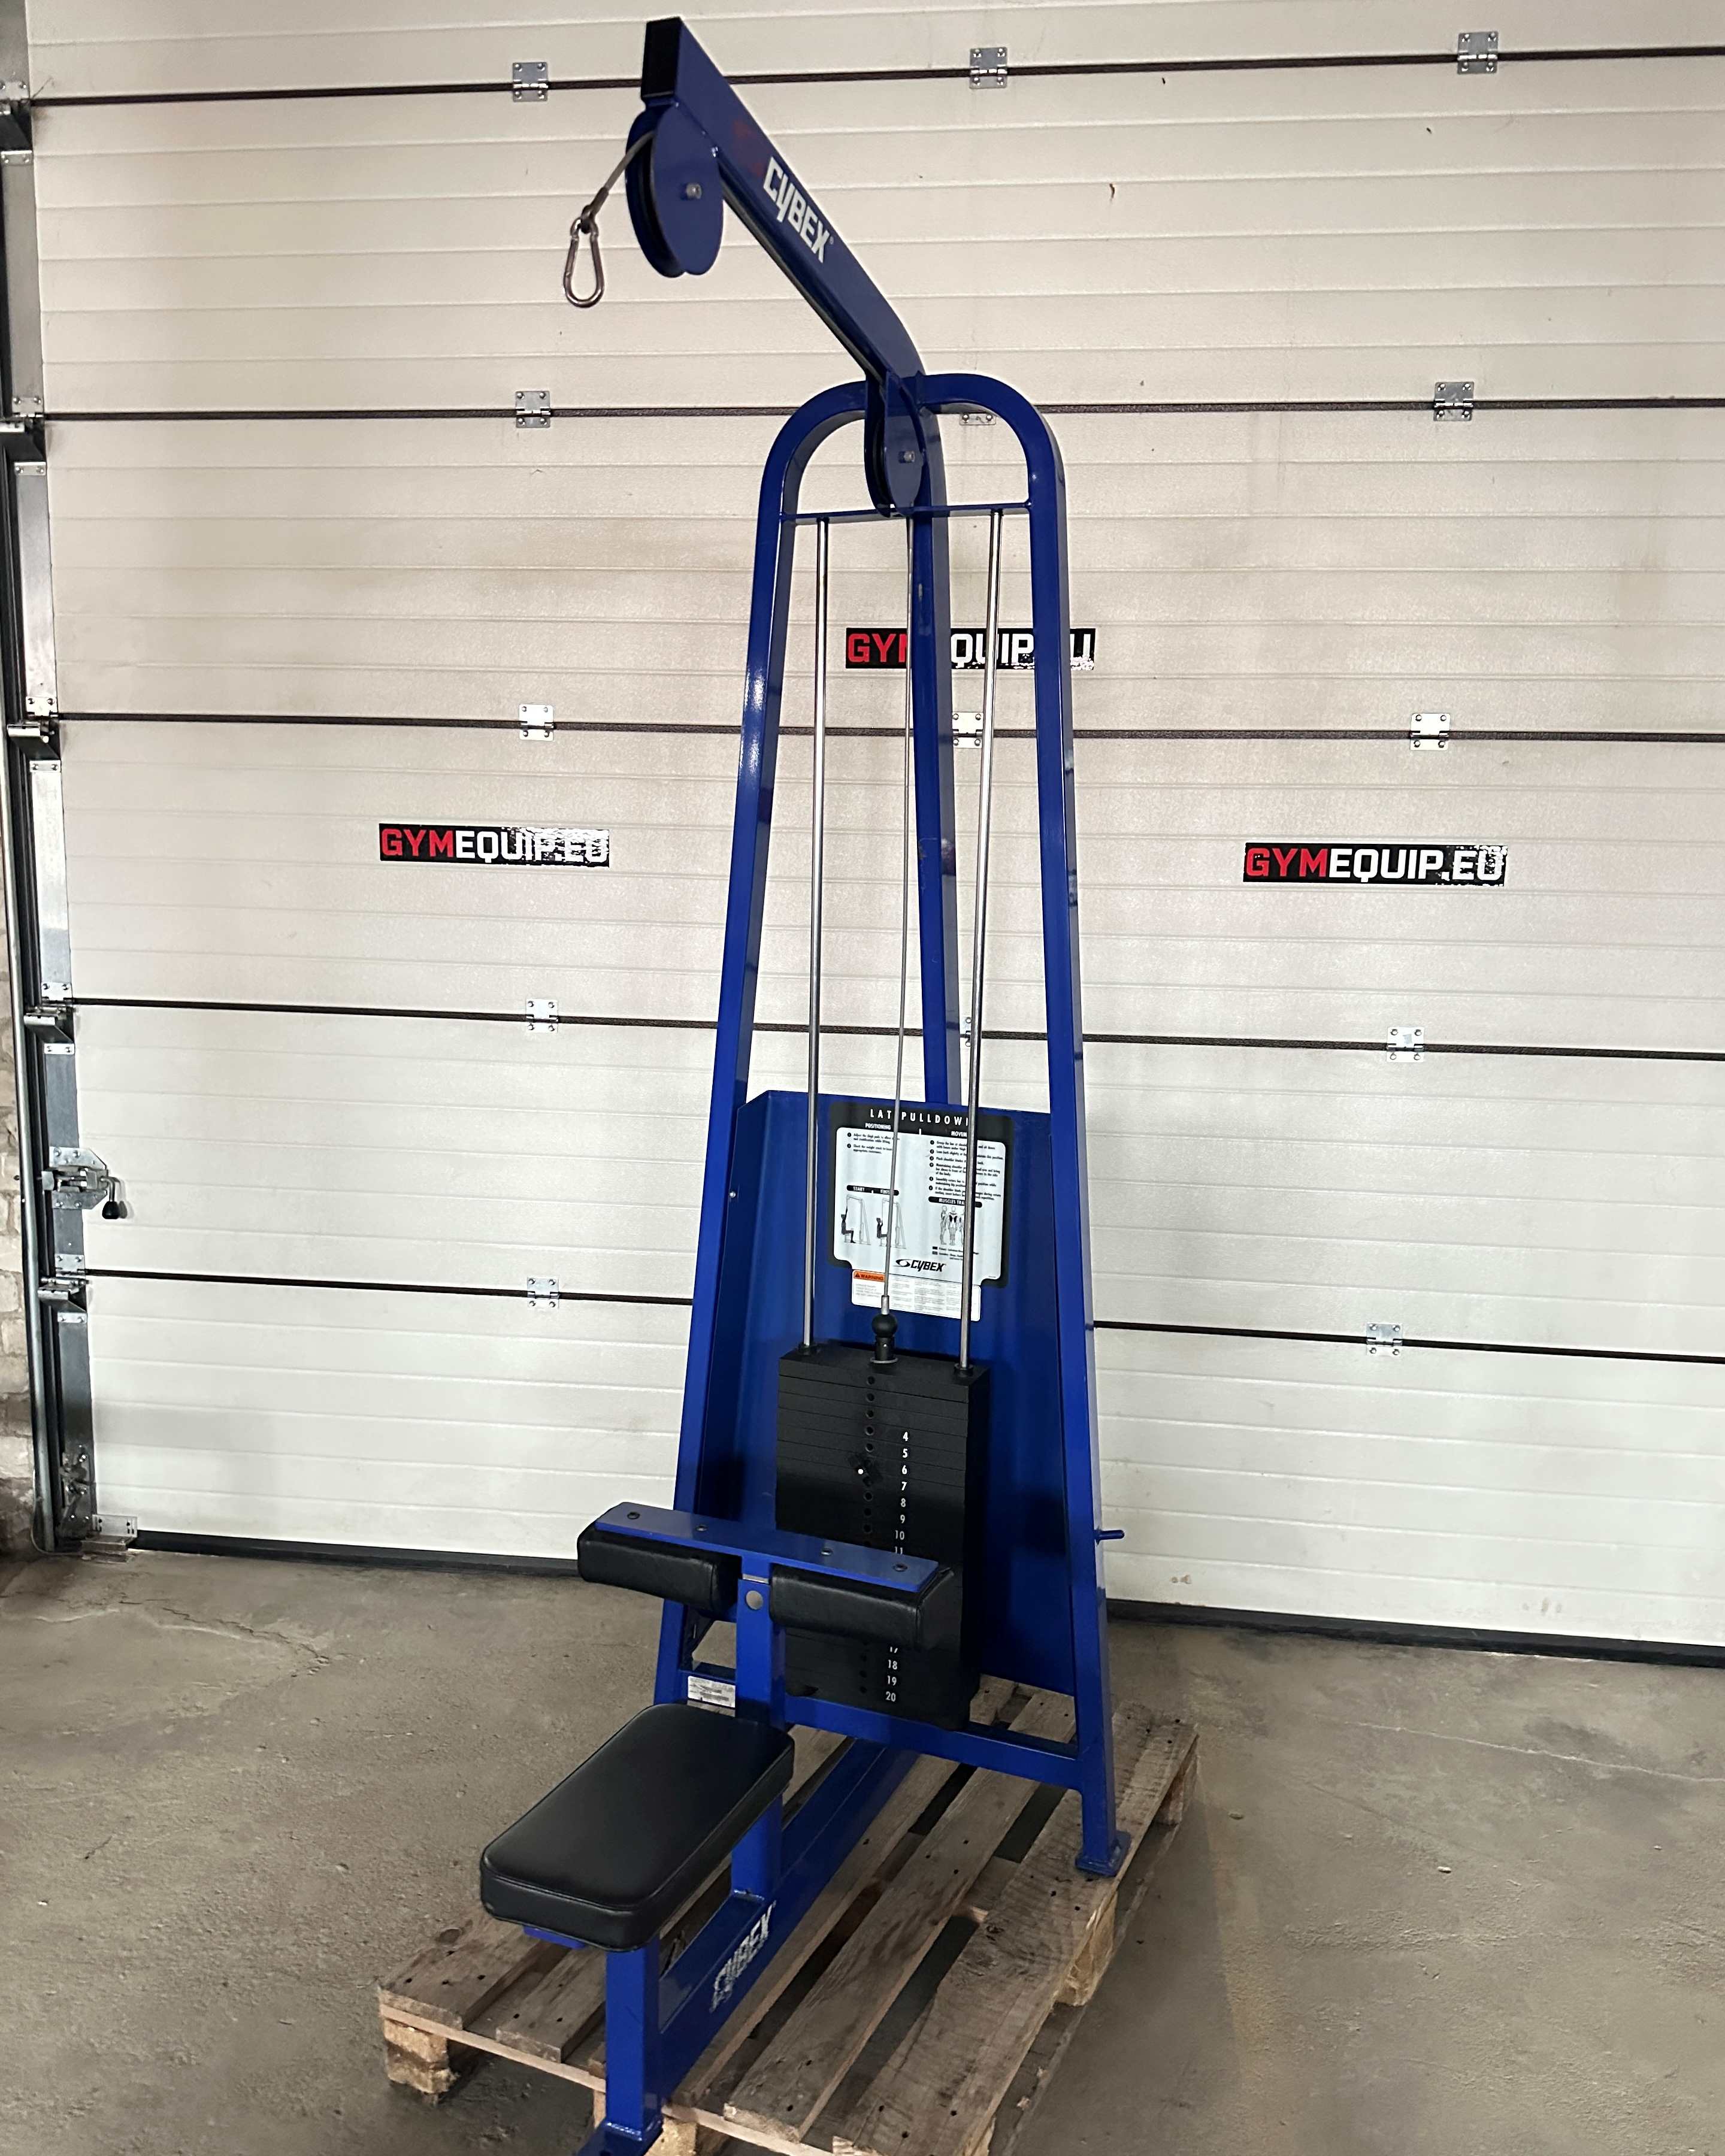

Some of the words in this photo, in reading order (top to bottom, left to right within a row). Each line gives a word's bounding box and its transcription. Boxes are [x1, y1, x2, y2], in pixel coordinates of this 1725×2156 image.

[763, 156, 830, 264] CYBEX
[1245, 847, 1503, 883] GYMEQUIP.EU
[870, 1109, 892, 1119] LAT
[901, 1112, 969, 1127] PULLDOW
[910, 1259, 945, 1272] CYBEX
[903, 1431, 909, 1442] 4
[902, 1448, 908, 1458] 5
[901, 1465, 907, 1475] 6
[901, 1481, 907, 1491] 7
[900, 1498, 906, 1507] 8
[900, 1514, 906, 1524] 9
[895, 1530, 905, 1540] 10
[888, 1659, 898, 1670] 18
[887, 1675, 897, 1686] 19
[886, 1691, 896, 1702] 20
